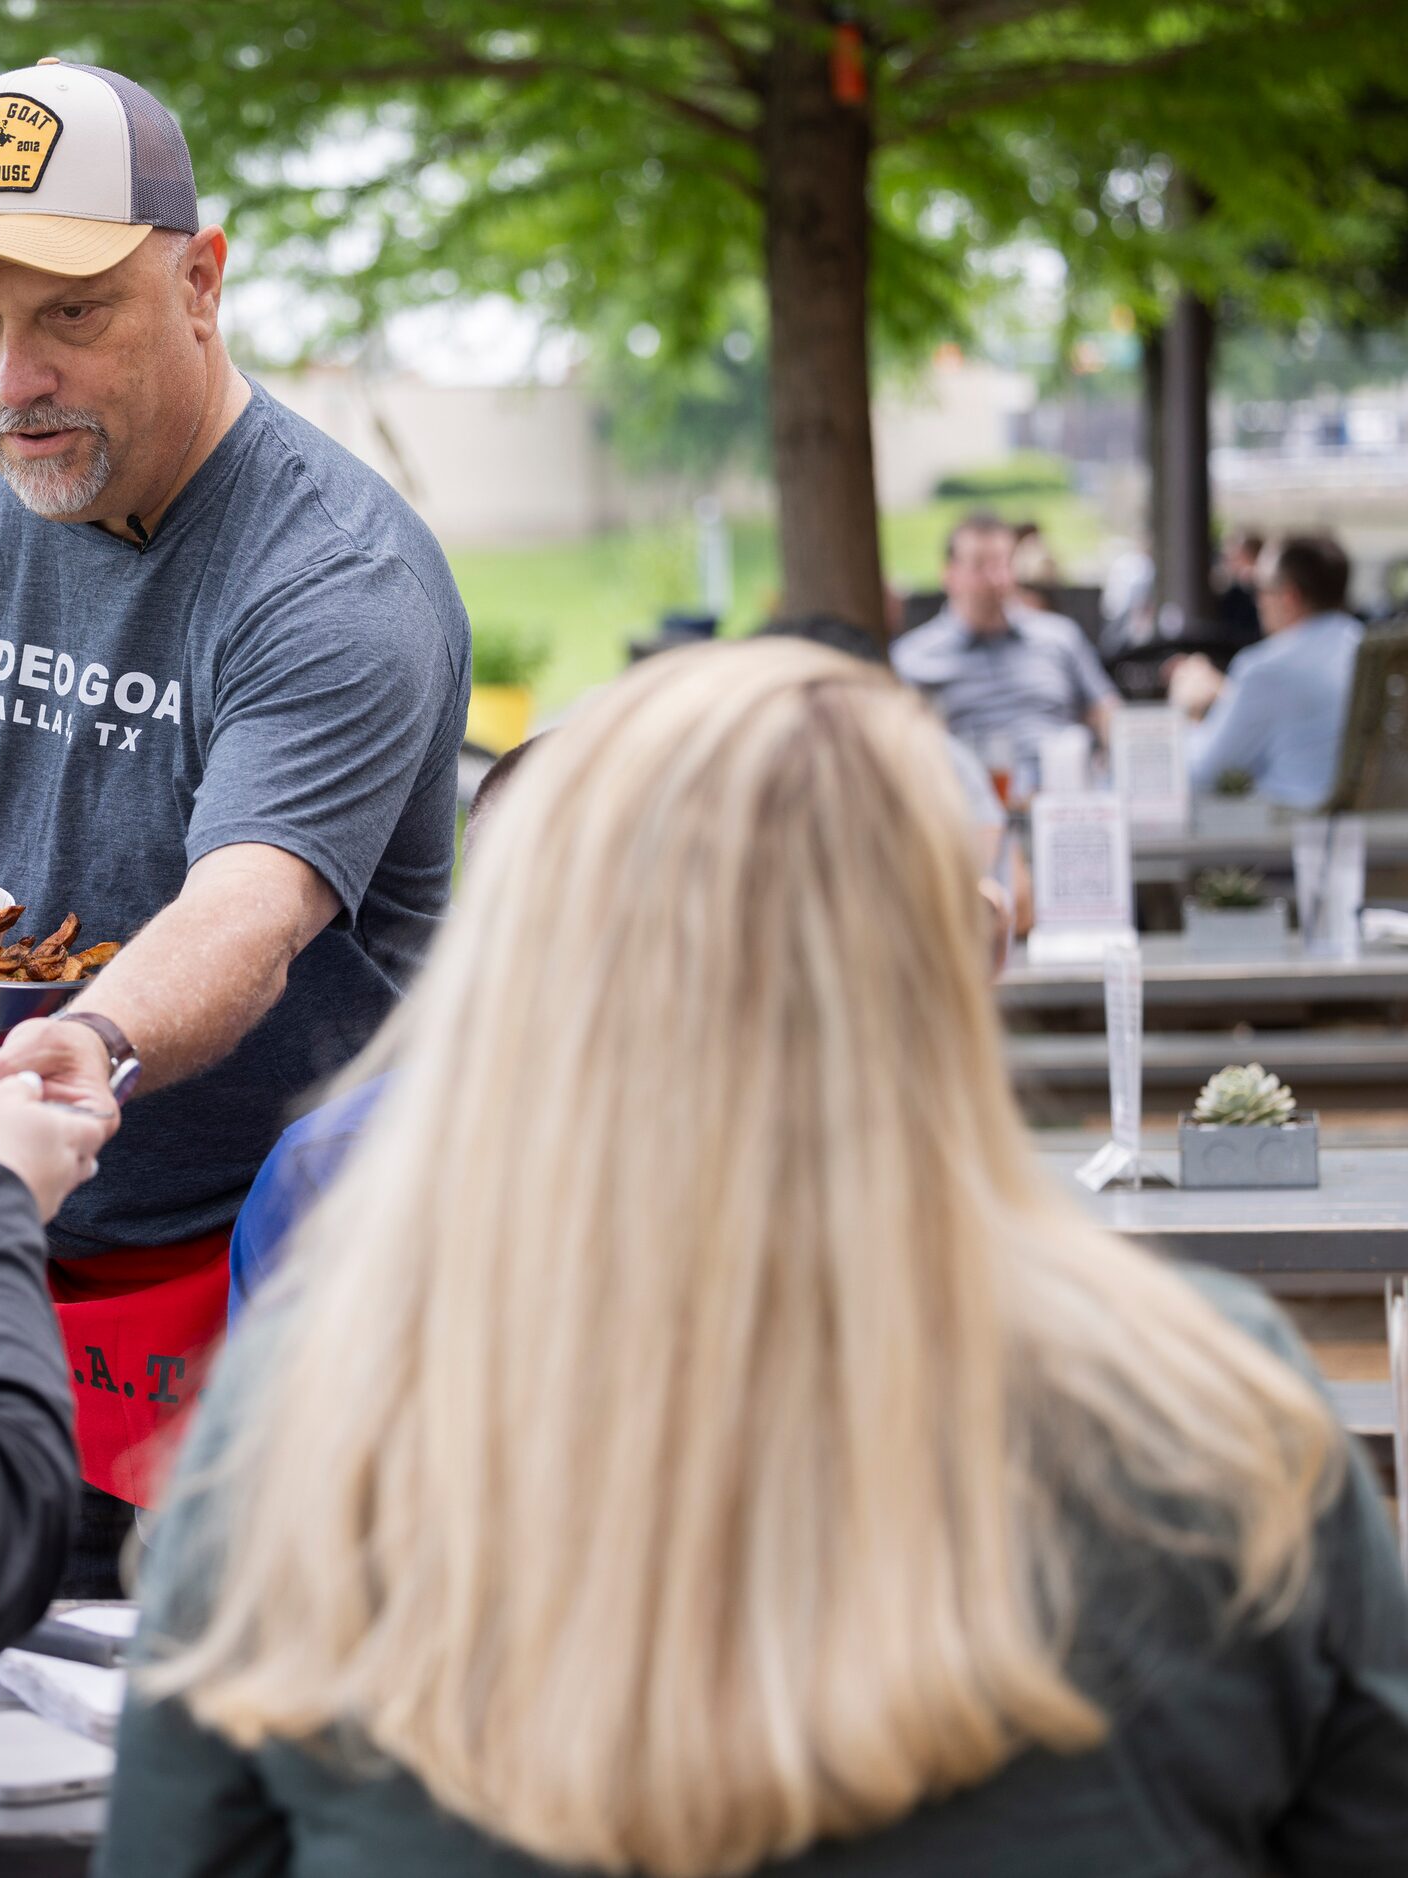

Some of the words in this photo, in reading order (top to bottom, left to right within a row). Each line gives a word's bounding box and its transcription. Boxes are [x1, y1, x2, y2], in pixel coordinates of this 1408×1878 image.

[7, 103, 52, 130] GOAT
[17, 141, 40, 152] 2012
[95, 722, 142, 751] TX
